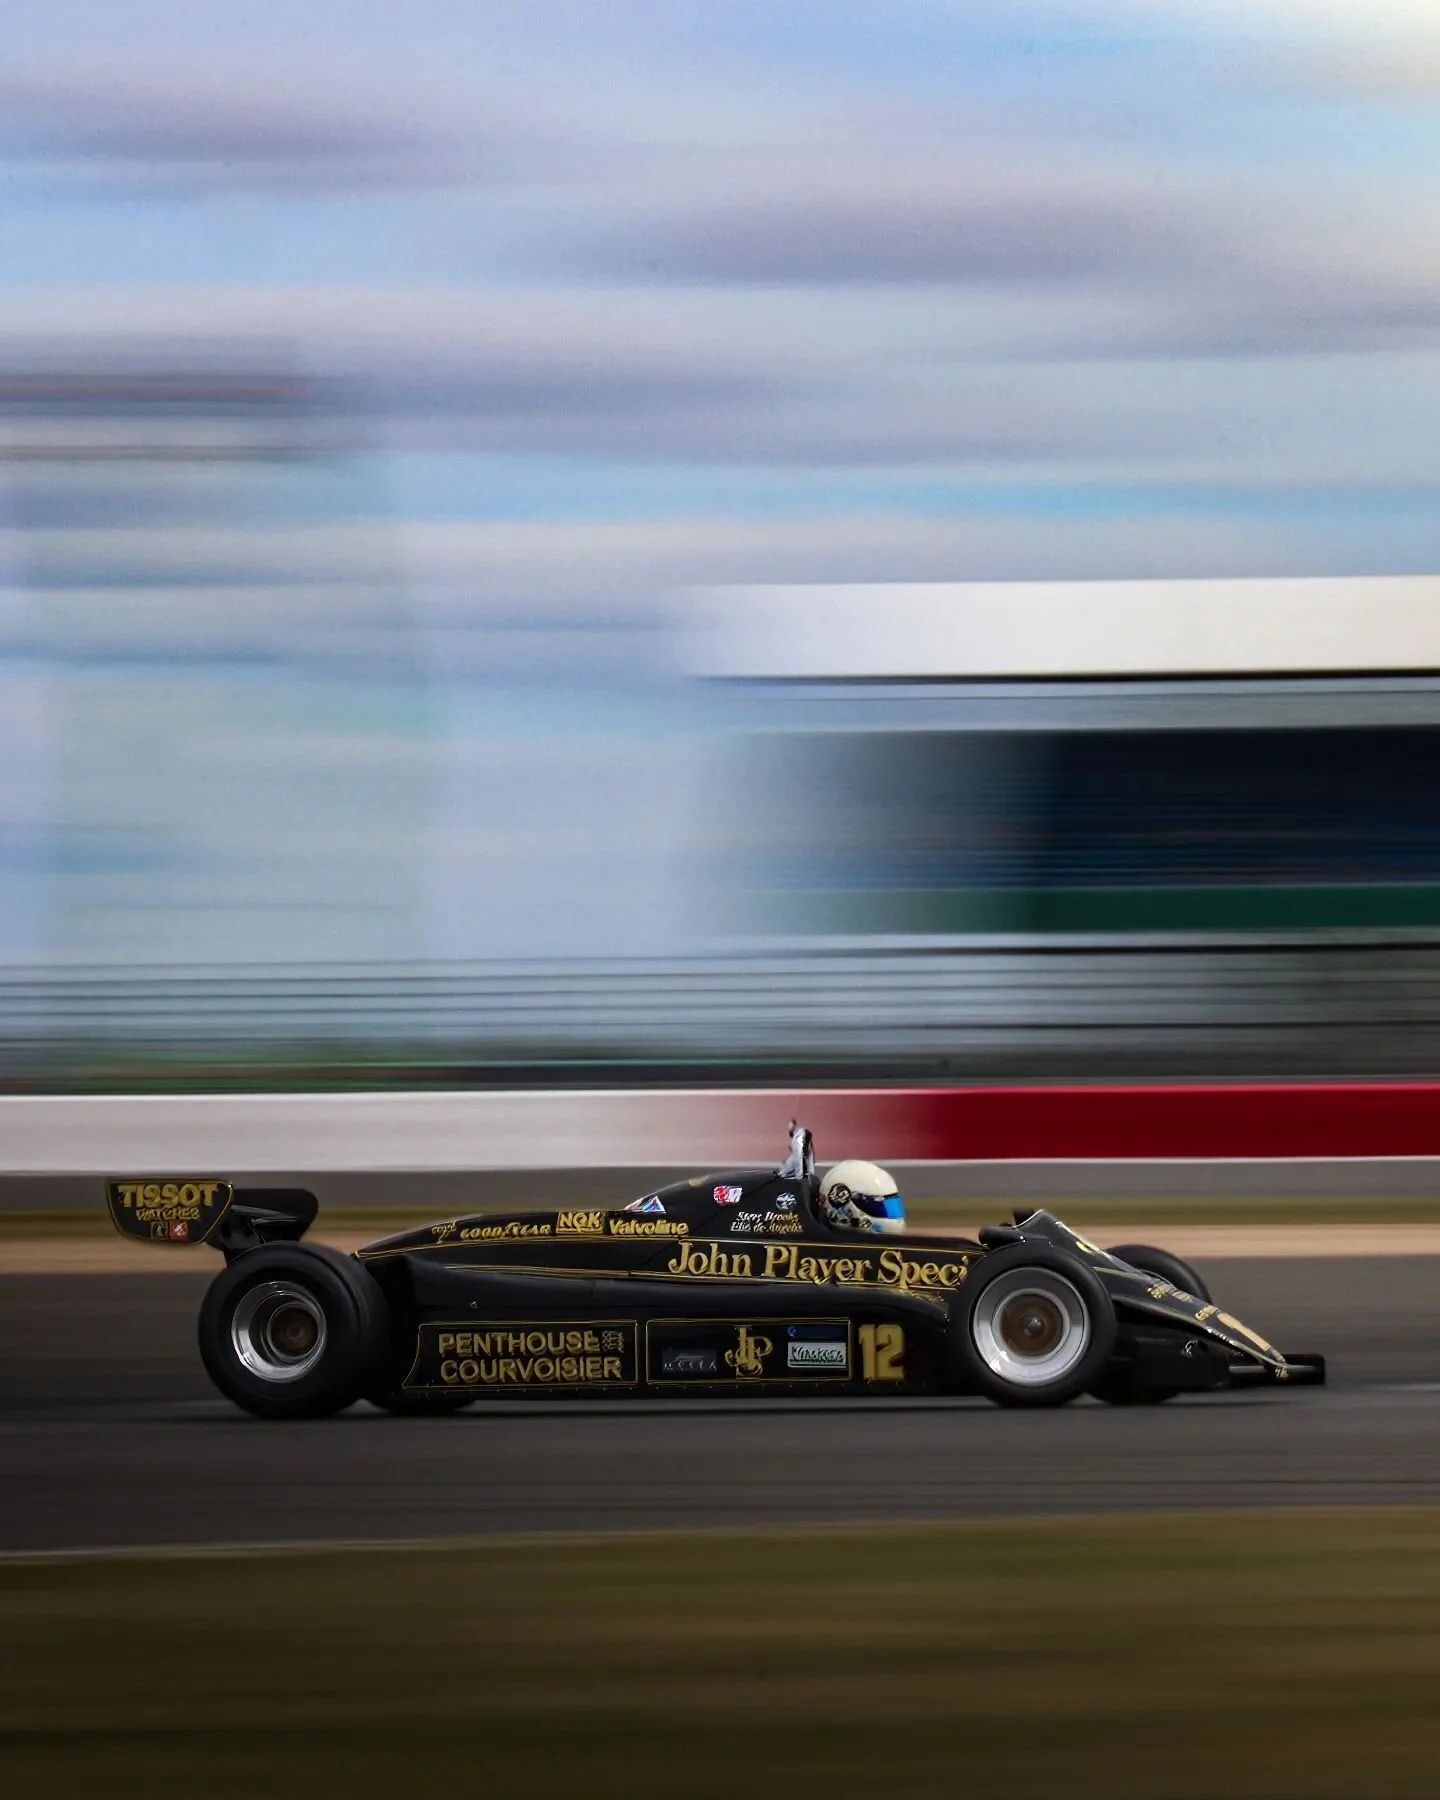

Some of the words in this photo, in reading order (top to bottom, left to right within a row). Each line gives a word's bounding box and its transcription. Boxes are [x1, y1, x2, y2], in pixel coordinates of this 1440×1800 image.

[118, 1183, 219, 1208] TISSOT
[559, 1211, 602, 1232] NGK
[609, 1219, 690, 1235] Valvoline
[668, 1241, 752, 1278] John
[761, 1244, 873, 1285] Player
[438, 1330, 601, 1357] PENTHOUSE
[858, 1323, 906, 1382] 12
[440, 1356, 622, 1384] COURVOISIER
